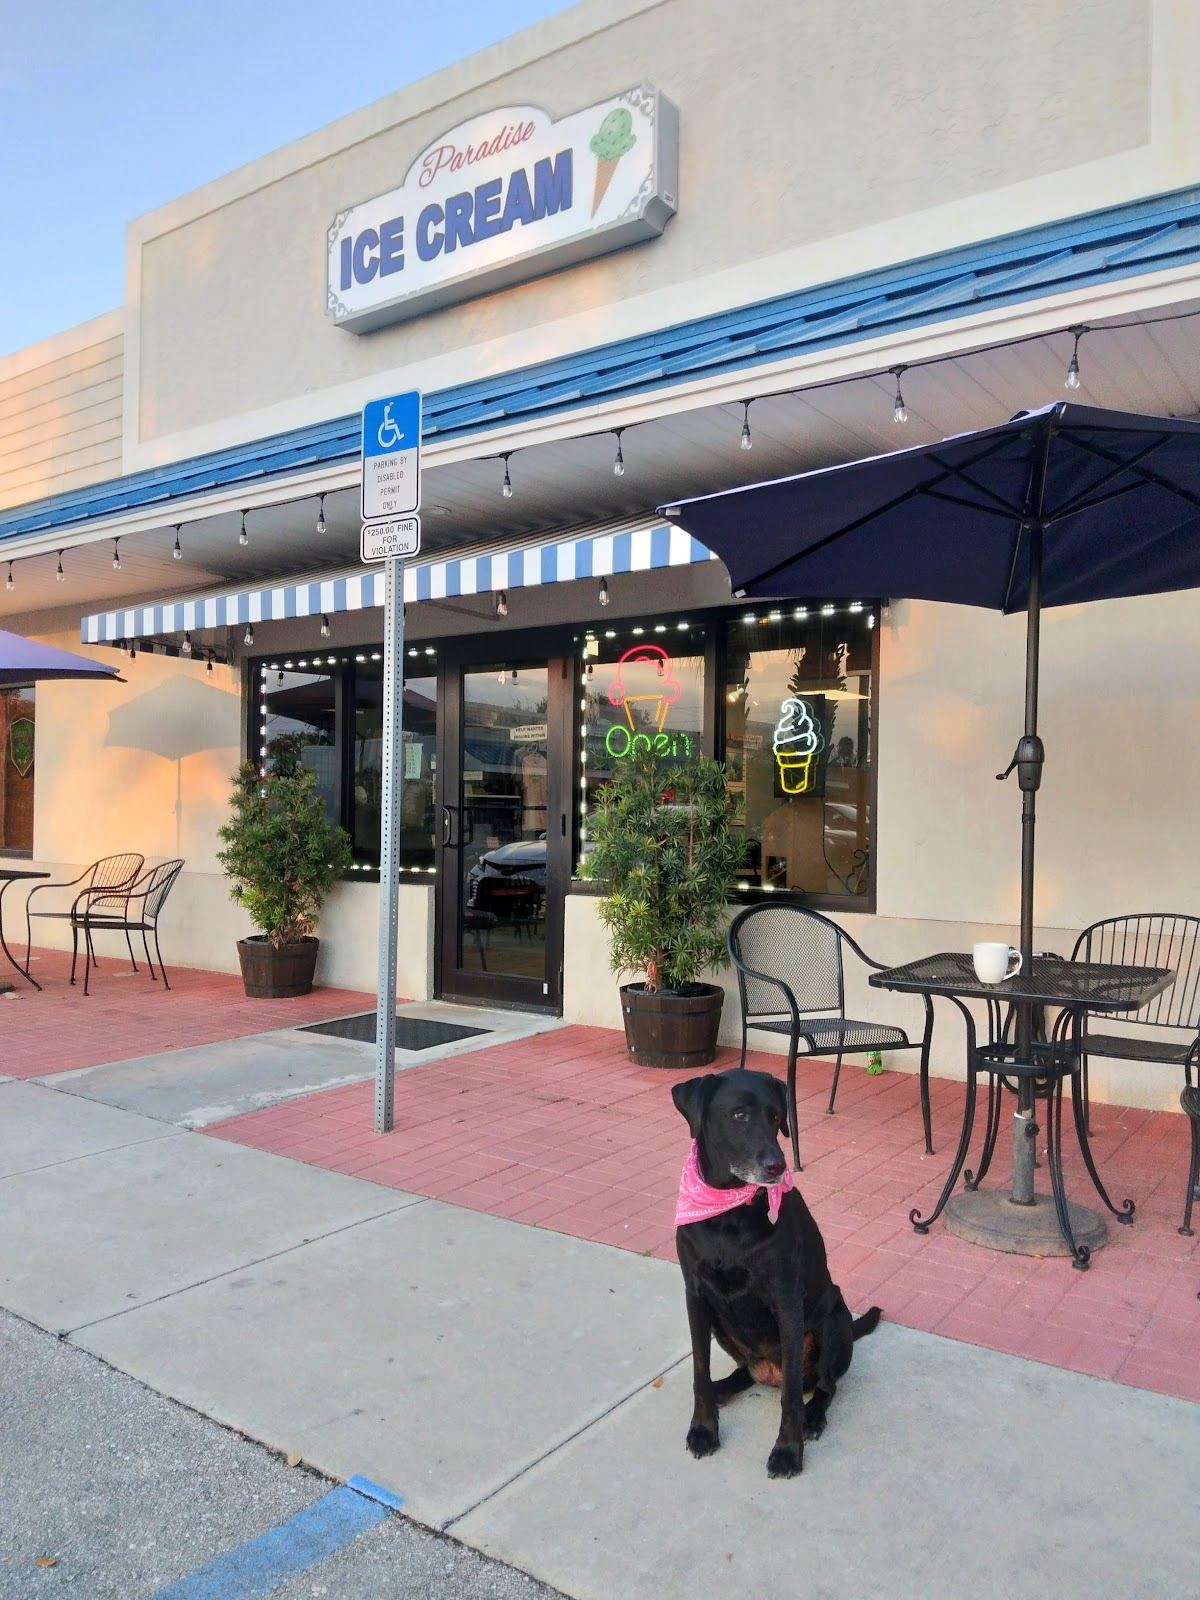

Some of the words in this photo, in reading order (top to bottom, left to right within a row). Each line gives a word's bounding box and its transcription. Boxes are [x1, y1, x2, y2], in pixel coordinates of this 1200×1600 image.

[419, 121, 536, 188] Paradise
[340, 216, 405, 291] ICE
[416, 148, 573, 262] CREAM
[373, 458, 398, 470] PARKING
[400, 456, 407, 465] BY
[377, 471, 403, 483] DISABLED
[380, 485, 400, 496] PERMIT
[382, 500, 398, 510] ONLY
[367, 525, 395, 537] $250.00
[397, 522, 414, 532] FINE
[382, 534, 398, 544] FOR
[371, 543, 409, 556] VIOLATION
